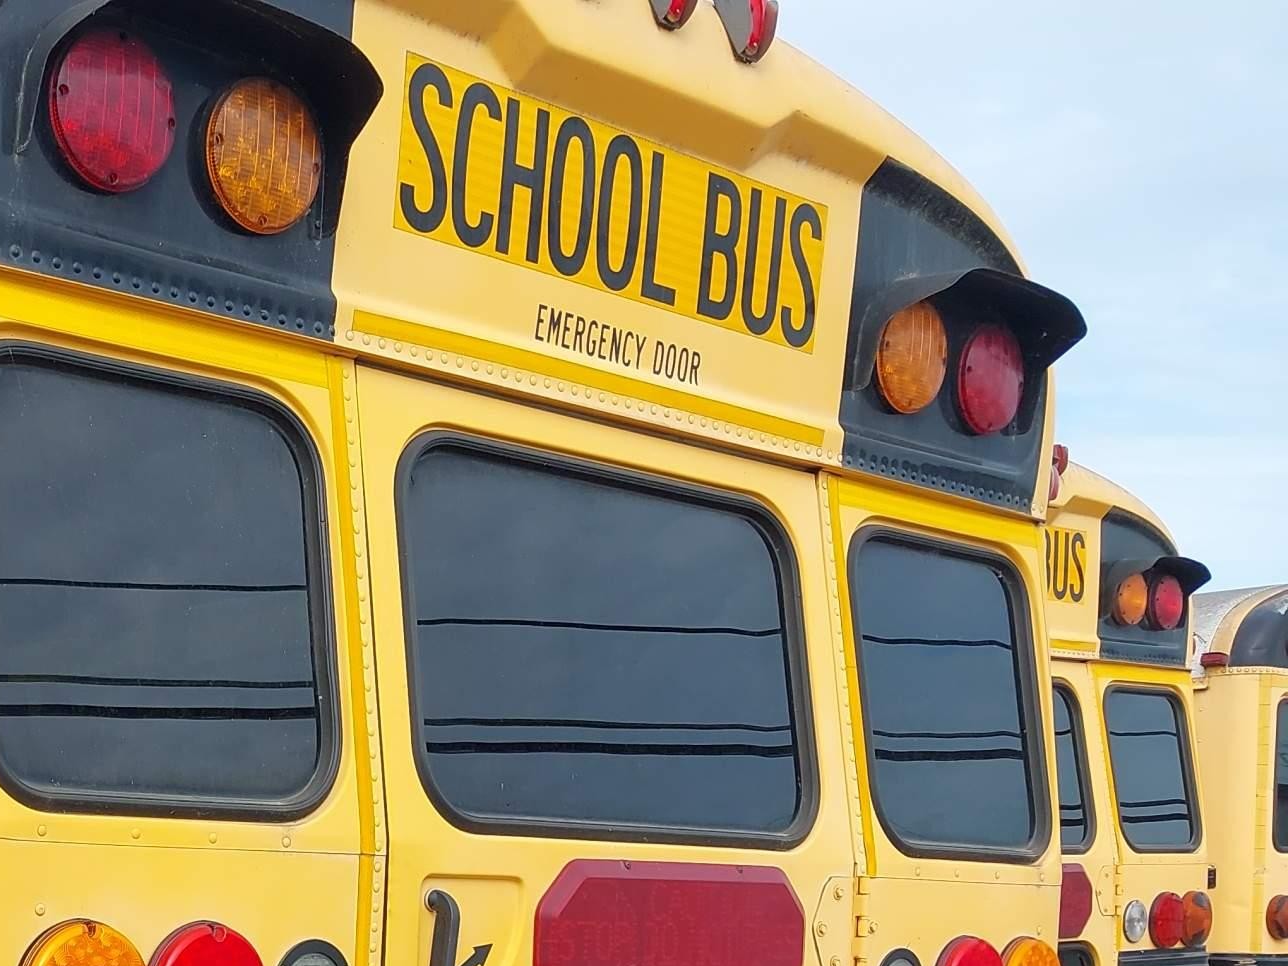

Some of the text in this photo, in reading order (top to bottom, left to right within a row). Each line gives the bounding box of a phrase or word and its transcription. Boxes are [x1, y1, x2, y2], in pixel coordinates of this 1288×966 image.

[399, 62, 823, 349] SCHOOL BUS
[534, 303, 702, 387] EMERGENCY DOOR
